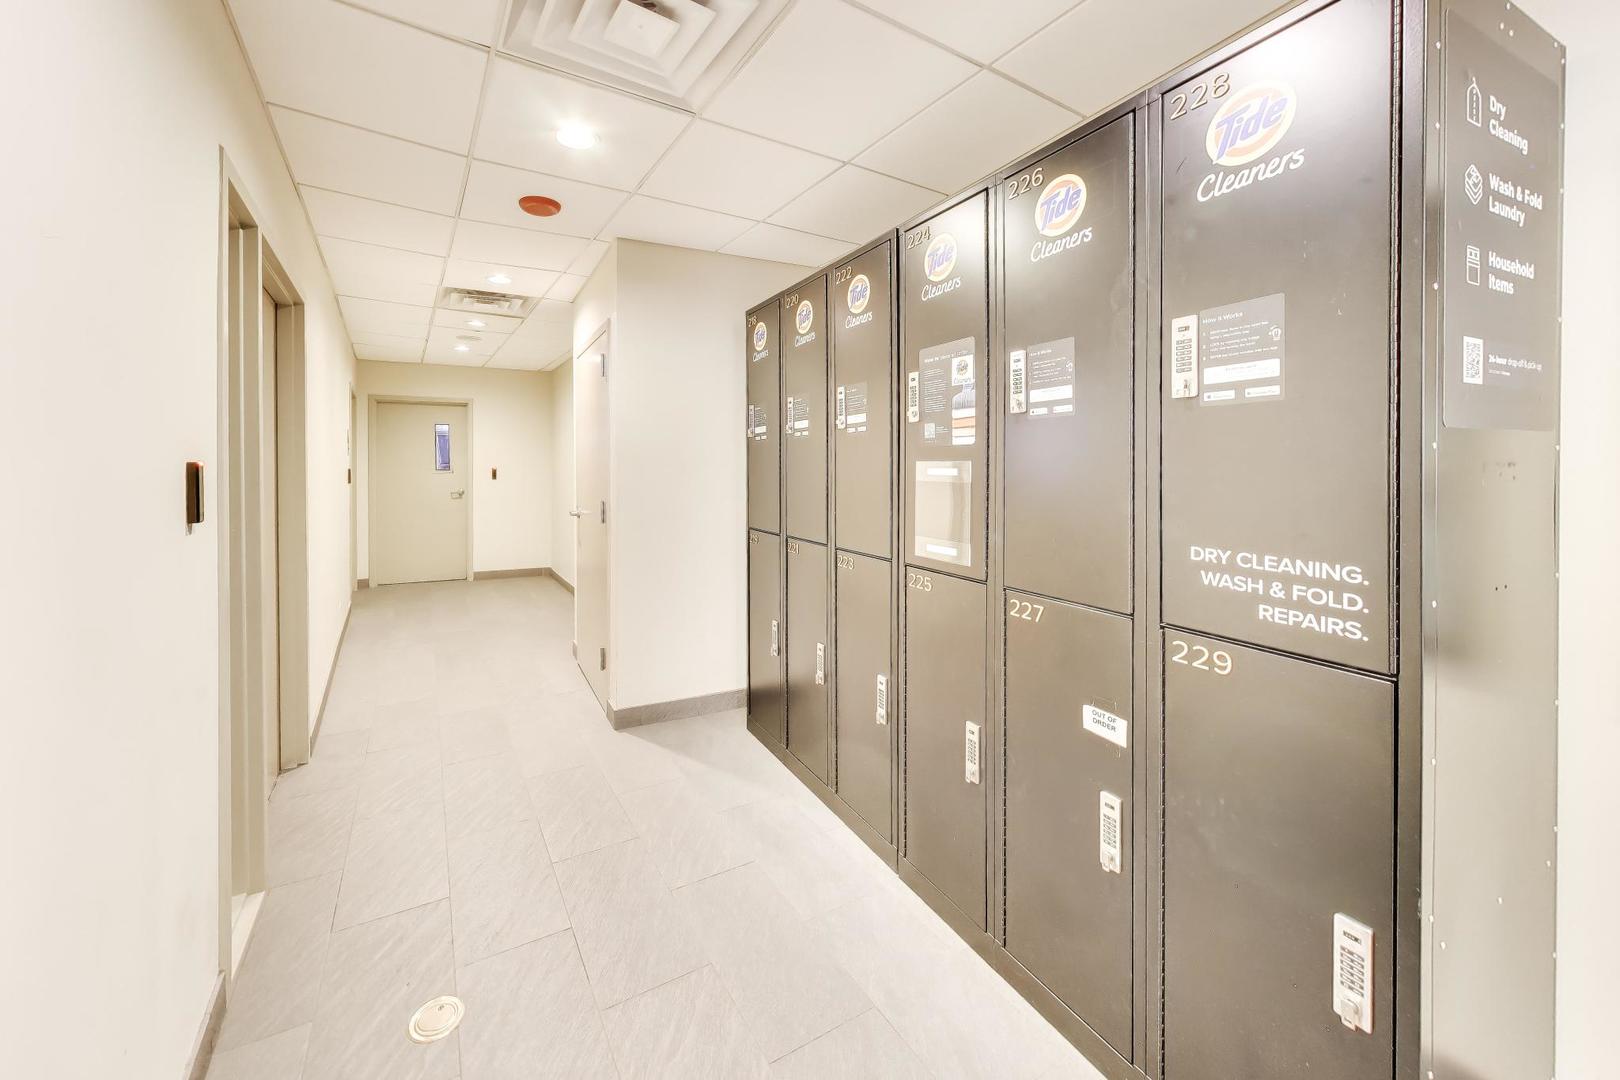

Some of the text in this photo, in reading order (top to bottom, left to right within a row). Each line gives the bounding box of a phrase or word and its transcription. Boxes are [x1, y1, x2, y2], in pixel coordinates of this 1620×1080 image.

[1169, 72, 1231, 120] 228
[1489, 95, 1507, 121] Dry
[1215, 96, 1289, 161] Tide
[1489, 119, 1529, 155] Cleaning
[1008, 167, 1044, 200] 226
[1196, 148, 1305, 202] Cleaners
[1489, 172, 1543, 210] Wash & Fold
[1039, 185, 1083, 231] Tide
[1488, 196, 1526, 227] Laundry
[907, 226, 932, 250] 224
[1030, 227, 1093, 262] Cleaners
[927, 243, 954, 277] Tide
[1488, 250, 1535, 280] Household
[835, 266, 853, 285] 222
[921, 277, 962, 302] Cleaners
[1488, 273, 1514, 295] Items
[849, 283, 869, 306] Tide
[797, 307, 812, 328] Tide
[844, 311, 873, 329] Cleaners
[837, 555, 855, 570] 223
[1190, 546, 1370, 586] DRY CLEANING.
[908, 573, 933, 592] 225
[1200, 570, 1370, 614] WASH & FOLD.
[1009, 599, 1045, 623] 227
[1258, 603, 1370, 642] REPAIRS.
[1171, 640, 1233, 675] 229
[1092, 709, 1118, 724] OUT OF
[1092, 717, 1117, 732] ORDER
